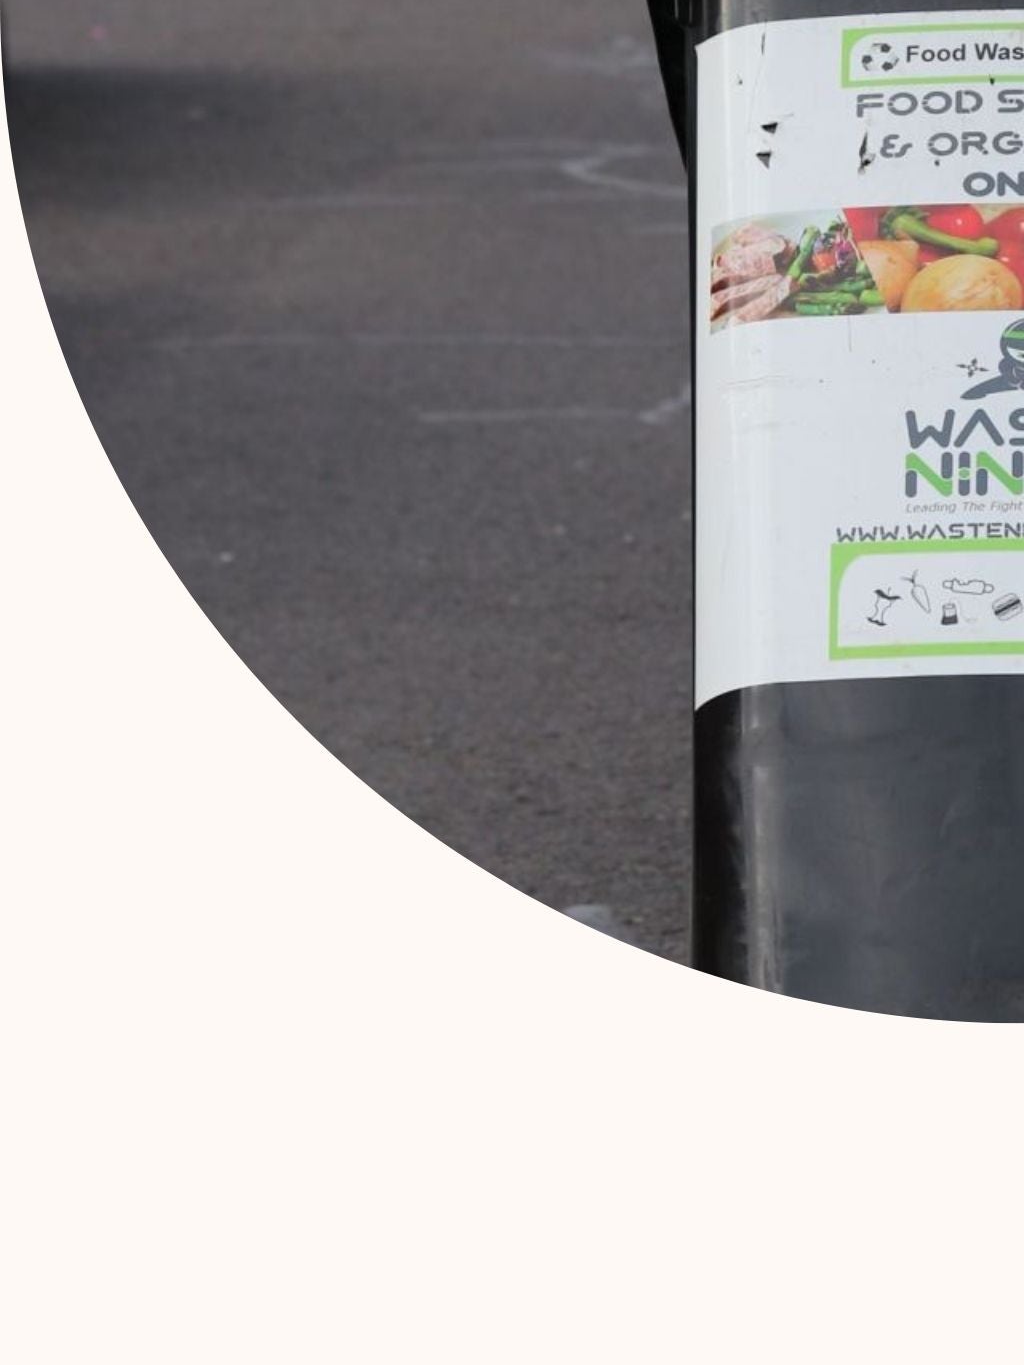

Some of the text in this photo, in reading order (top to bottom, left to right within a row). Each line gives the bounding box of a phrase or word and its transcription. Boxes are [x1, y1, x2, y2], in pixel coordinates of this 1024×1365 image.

[906, 44, 966, 63] Food
[856, 89, 984, 117] FOOD
[880, 134, 913, 158] &
[905, 502, 957, 514] Leading
[962, 501, 986, 512] The
[990, 500, 1023, 513] Fight
